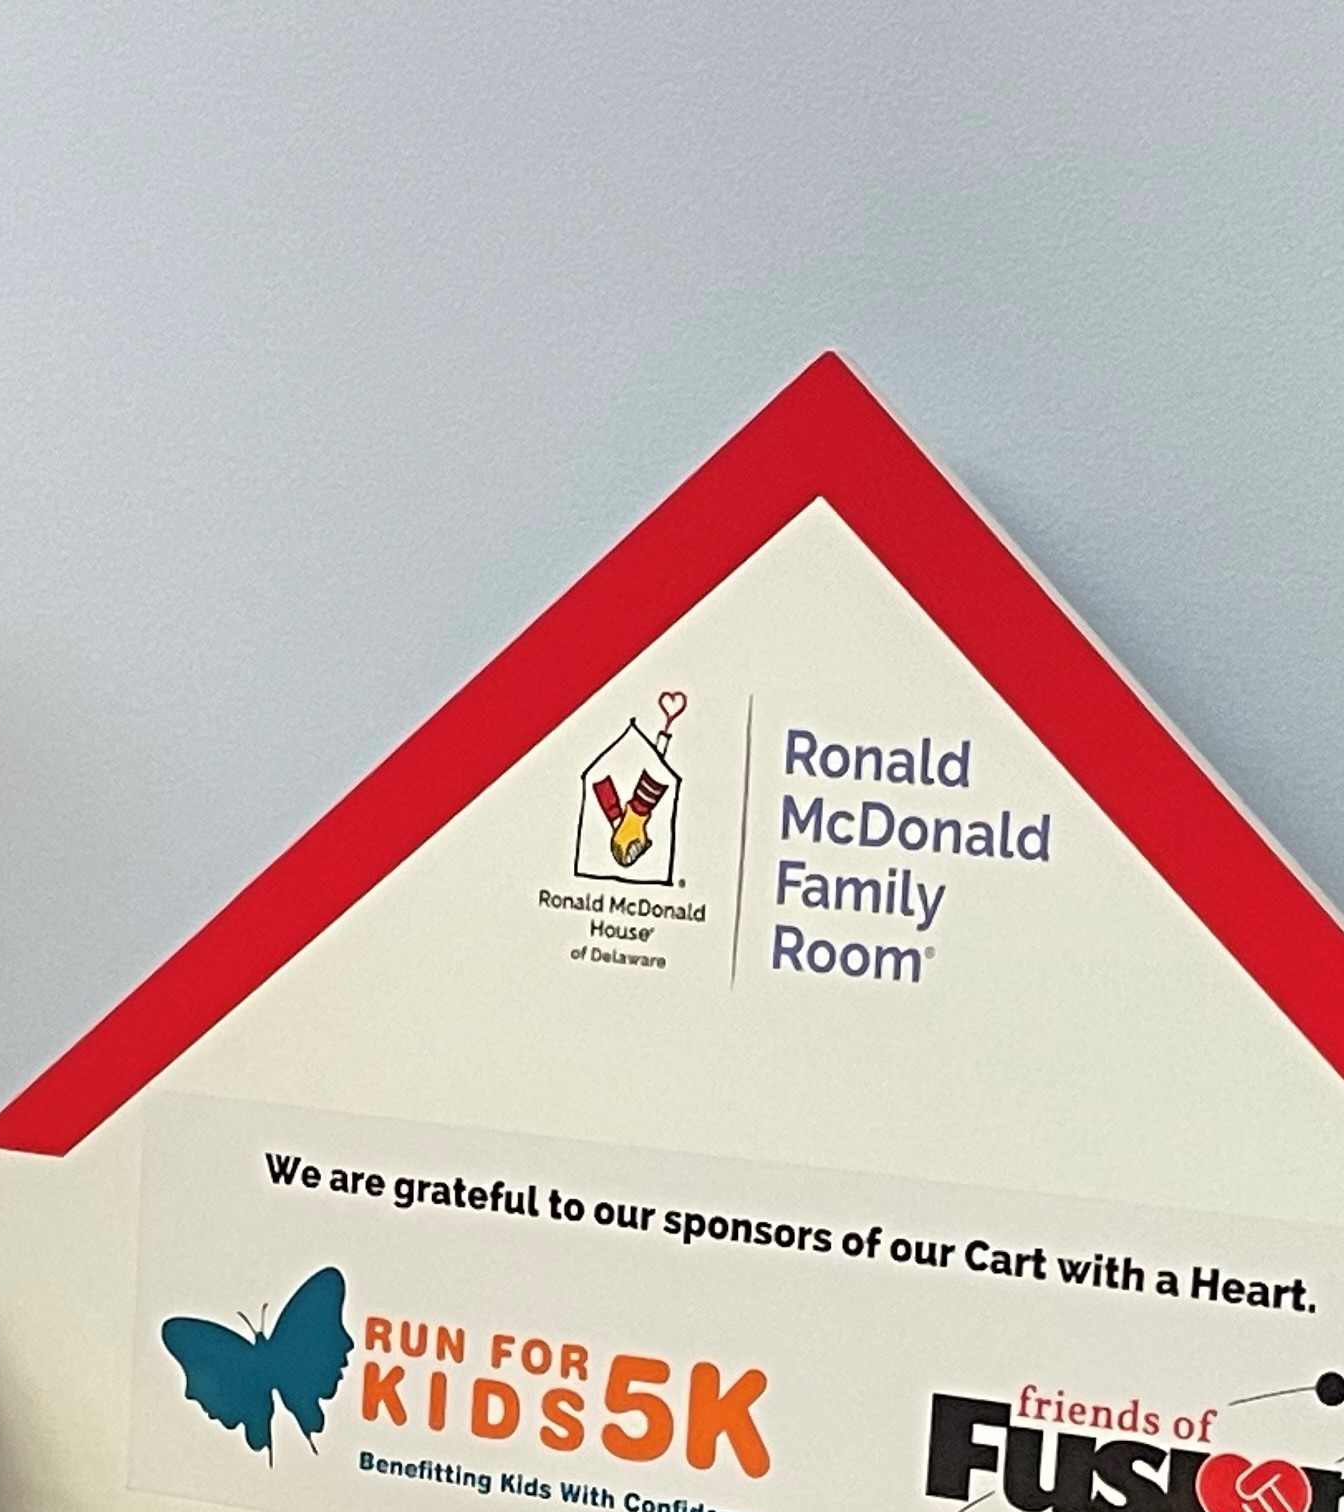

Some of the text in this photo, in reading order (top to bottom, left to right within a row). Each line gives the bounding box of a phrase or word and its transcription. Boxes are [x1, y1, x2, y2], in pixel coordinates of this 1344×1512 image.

[785, 729, 971, 788] Ronald
[781, 795, 1051, 861] McDonald
[539, 889, 706, 922] Ronald McDonald
[776, 860, 946, 931] Family
[570, 945, 667, 969] of Delaware
[265, 1153, 1317, 1313] We are grateful to our sponsors of our Cart with a Heart.
[364, 1317, 590, 1380] RUN FOR
[362, 1361, 586, 1452] KIDS
[602, 1354, 771, 1480] 5K
[1017, 1385, 1218, 1443] friends of
[359, 1451, 492, 1496] Benefitting
[500, 1472, 552, 1500] Kids
[561, 1482, 616, 1510] With
